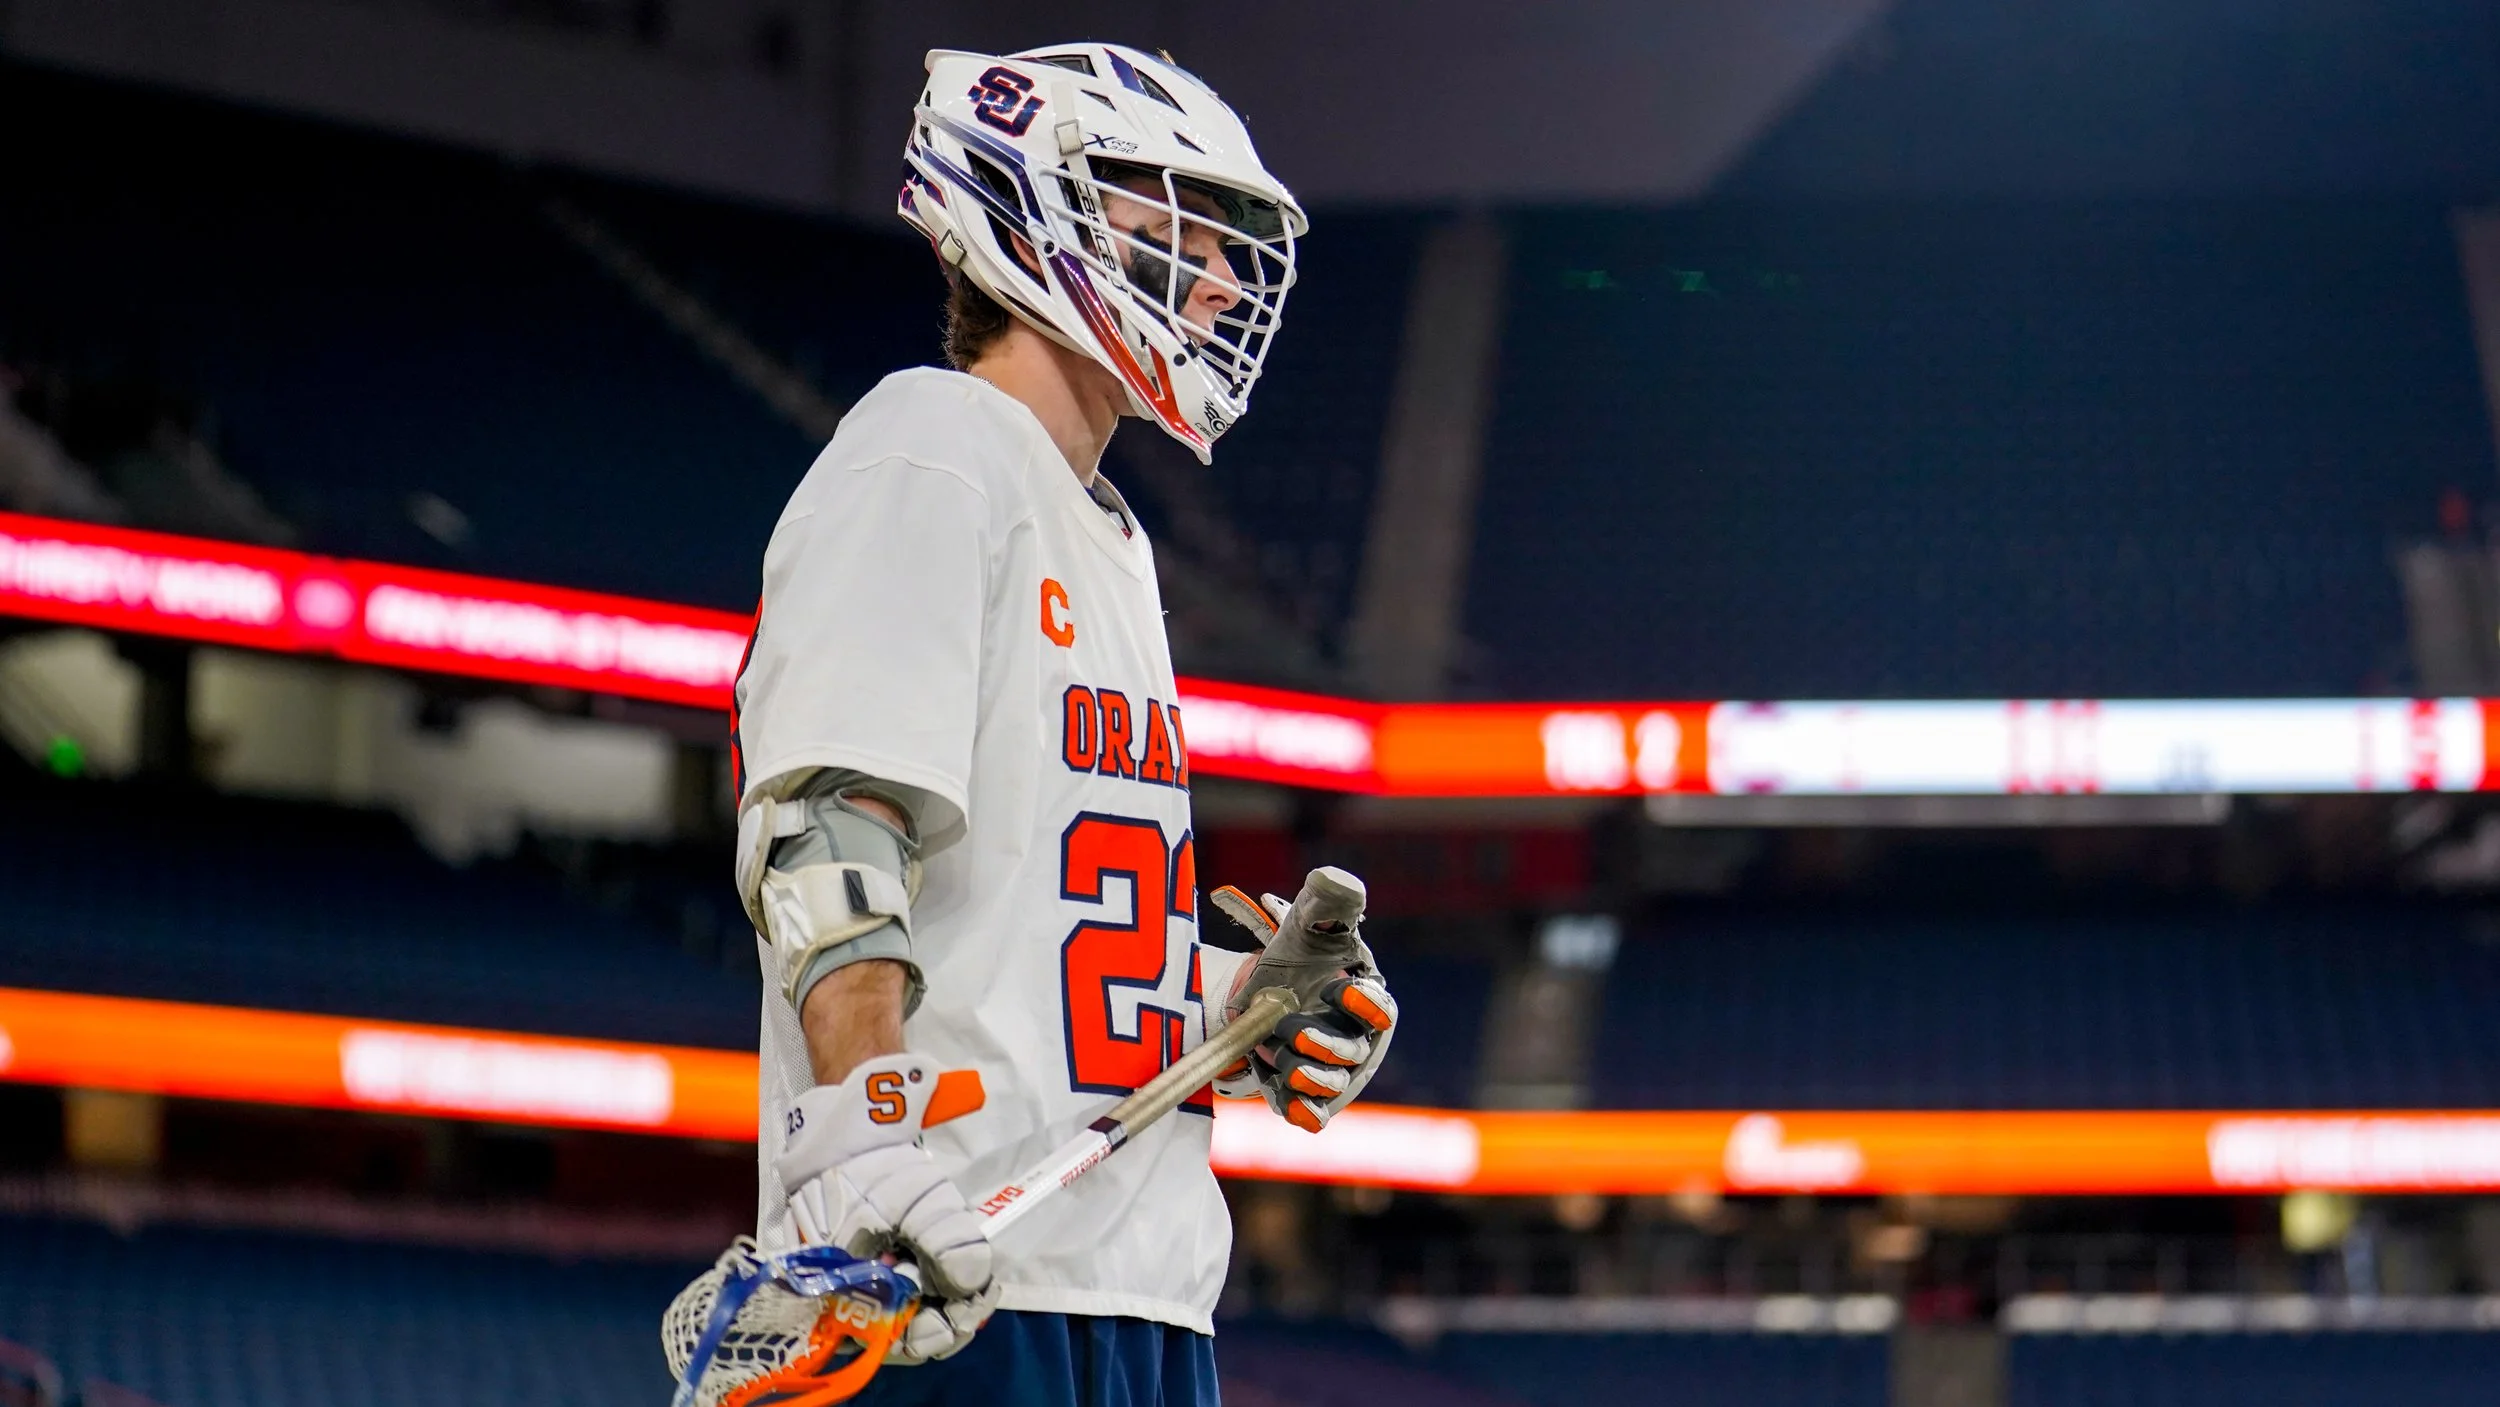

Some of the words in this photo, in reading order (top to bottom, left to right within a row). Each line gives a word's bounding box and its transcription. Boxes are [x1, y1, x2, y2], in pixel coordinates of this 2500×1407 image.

[967, 65, 1045, 138] SU
[1041, 577, 1075, 648] C
[787, 1107, 804, 1136] 23
[866, 1071, 907, 1124] S
